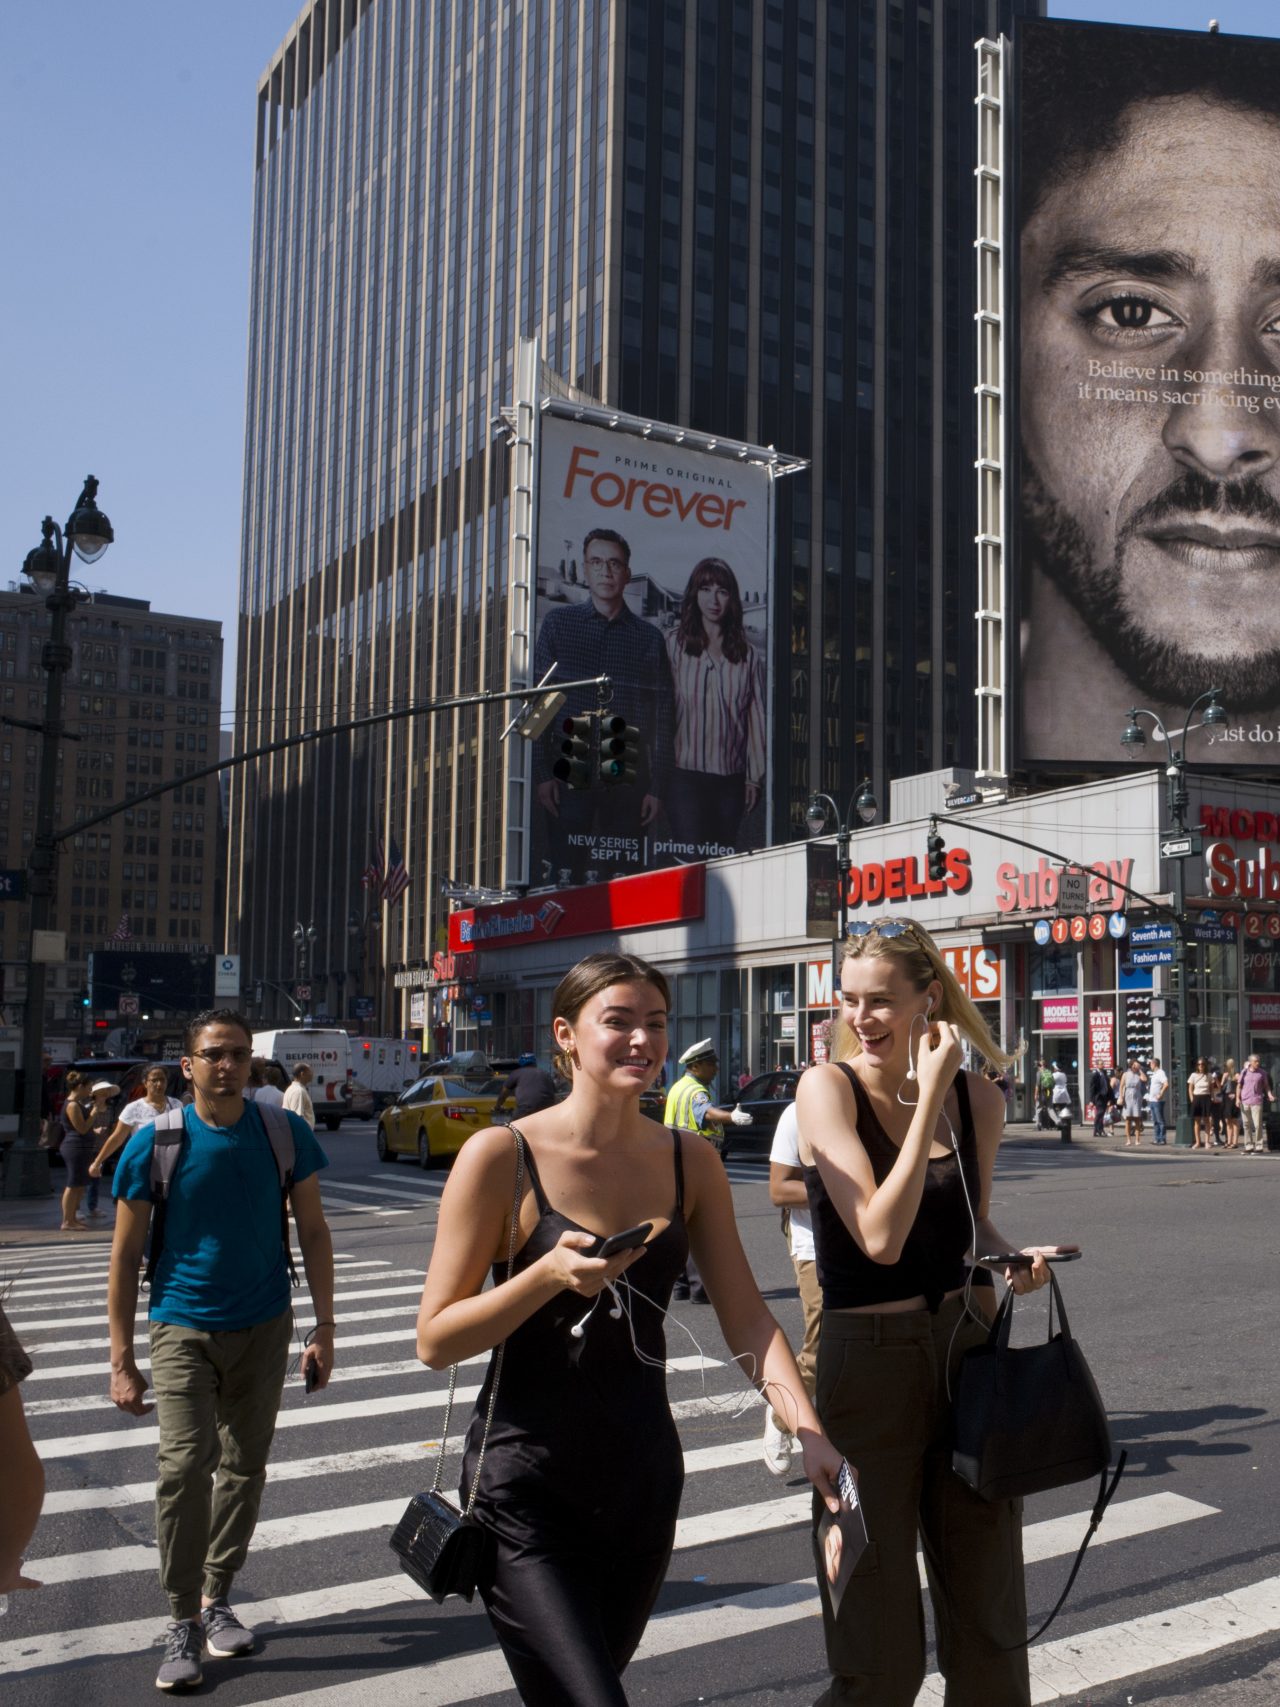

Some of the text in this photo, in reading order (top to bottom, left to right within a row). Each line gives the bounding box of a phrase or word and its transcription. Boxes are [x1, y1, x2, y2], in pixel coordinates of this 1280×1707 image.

[1088, 359, 1157, 381] Believe
[1160, 364, 1181, 382] in
[1078, 382, 1093, 400] it
[1095, 388, 1159, 404] means
[1162, 388, 1260, 413] sacrificing
[614, 455, 733, 489] PRIME ORIGINAL
[563, 446, 746, 530] Forever
[1249, 724, 1273, 743] do
[568, 834, 639, 850] NEW SERIES
[653, 838, 735, 856] prime video
[591, 848, 639, 862] SEPT 14
[1067, 879, 1080, 889] NO
[1062, 891, 1084, 901] TURNS
[1057, 923, 1063, 939] 1
[1074, 920, 1083, 937] 2
[1093, 918, 1102, 936] 3
[1195, 928, 1211, 938] West
[1226, 930, 1233, 940] St
[1250, 917, 1258, 934] 2
[1271, 918, 1279, 935] 3
[1132, 929, 1172, 942] Seventh Ave
[1133, 951, 1172, 964] Fashion Ave
[285, 1053, 319, 1061] BELFOR
